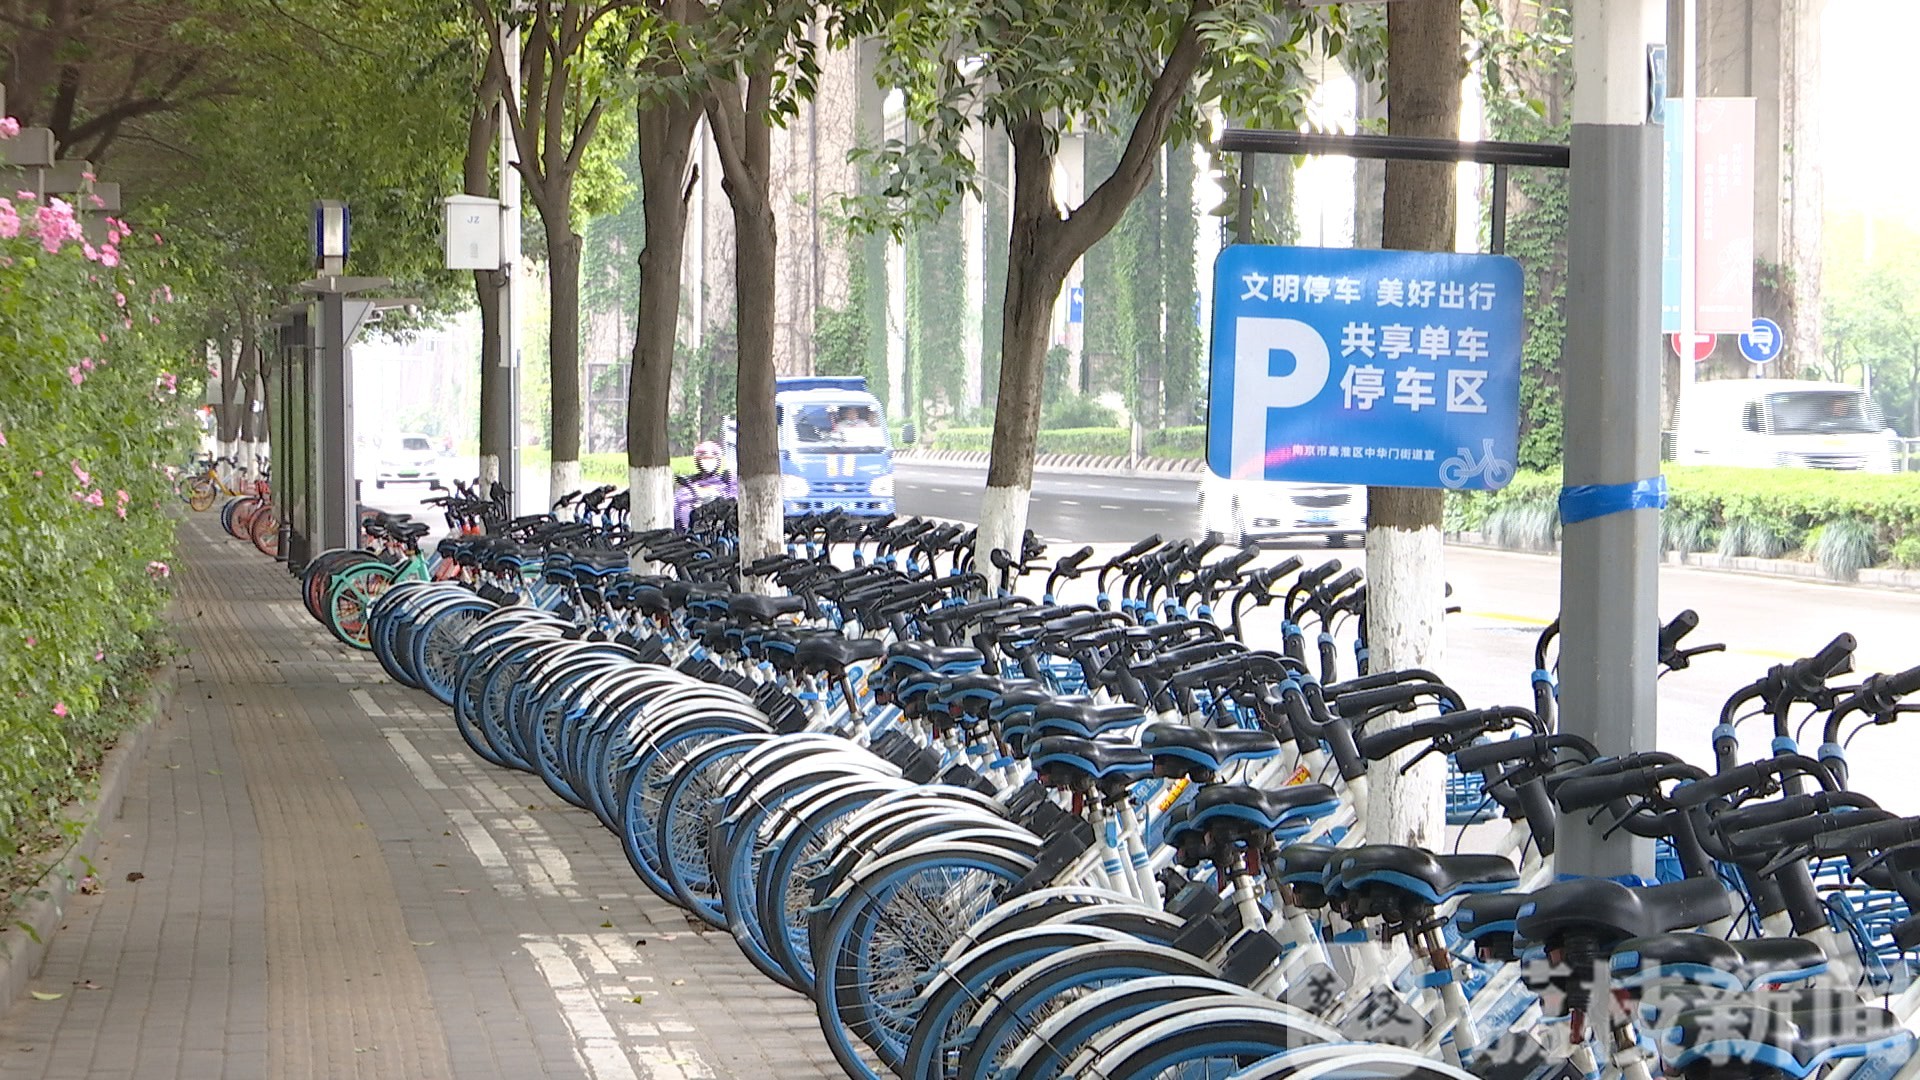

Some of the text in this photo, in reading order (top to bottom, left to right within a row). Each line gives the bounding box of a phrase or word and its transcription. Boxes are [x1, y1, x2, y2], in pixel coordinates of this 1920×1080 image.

[466, 215, 480, 225] JZ
[1240, 272, 1496, 311] 文明停车 美好出行
[1341, 321, 1489, 362] 共享单车
[1230, 316, 1331, 480] P
[1340, 364, 1489, 414] 停车区
[1292, 444, 1435, 461] 南京市秦淮区中华门街道宣
